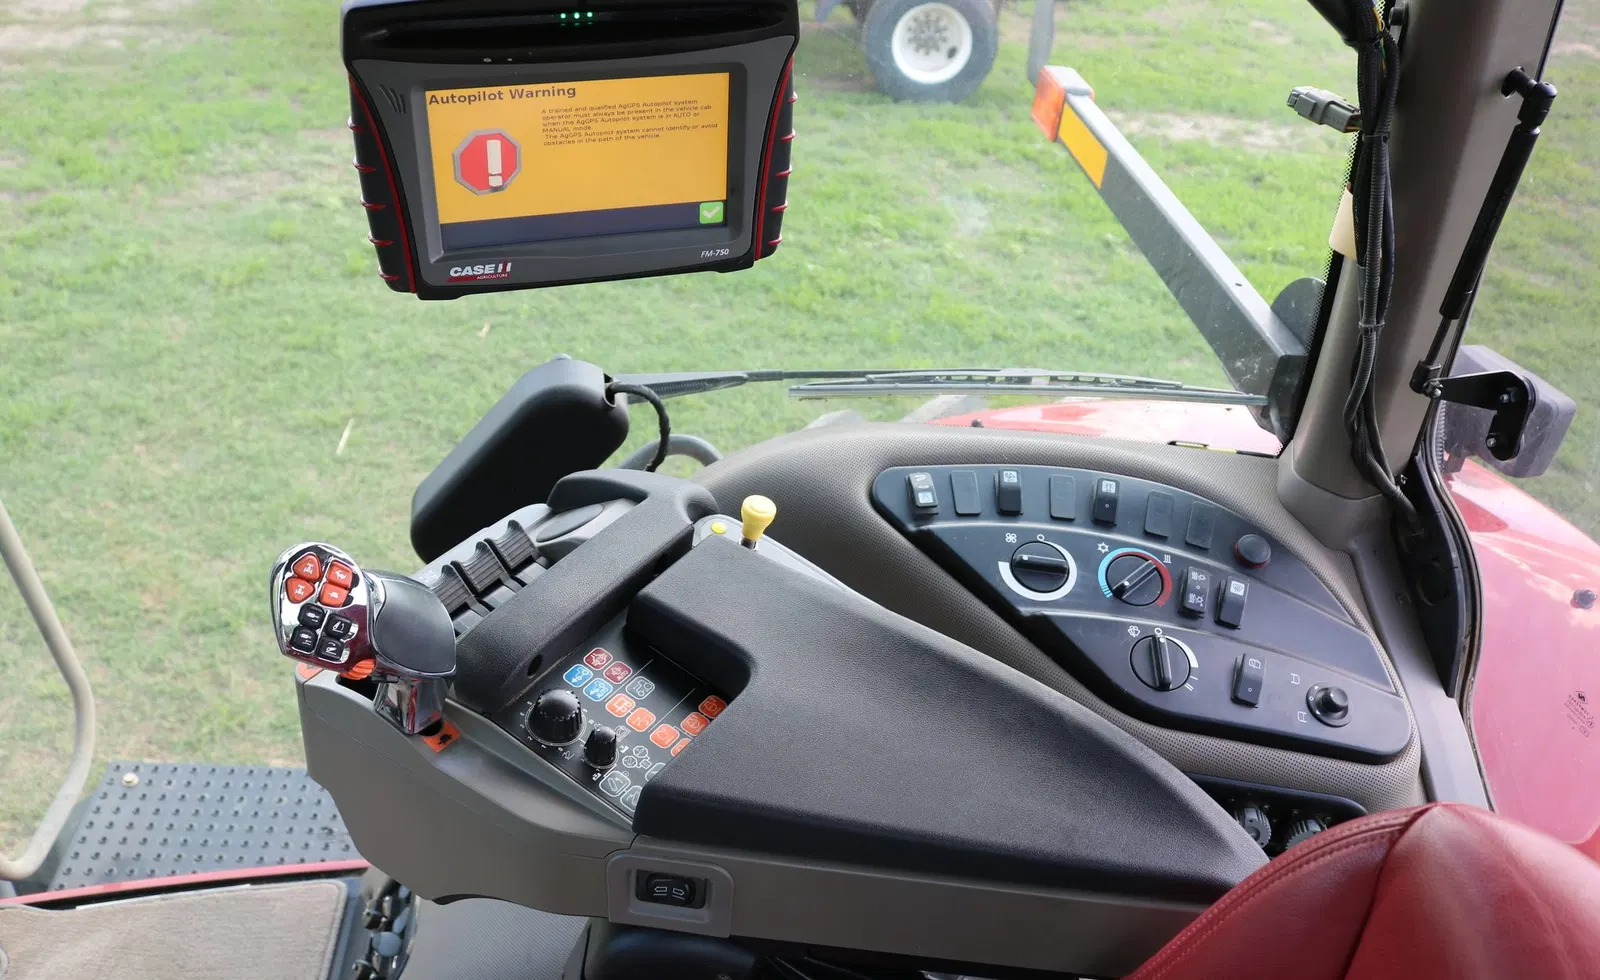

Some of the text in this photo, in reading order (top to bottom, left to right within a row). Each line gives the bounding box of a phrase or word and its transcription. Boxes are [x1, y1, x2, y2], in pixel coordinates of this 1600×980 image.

[428, 86, 576, 105] Autopilot Warning
[700, 248, 730, 258] FM-750
[450, 264, 496, 277] CASE
